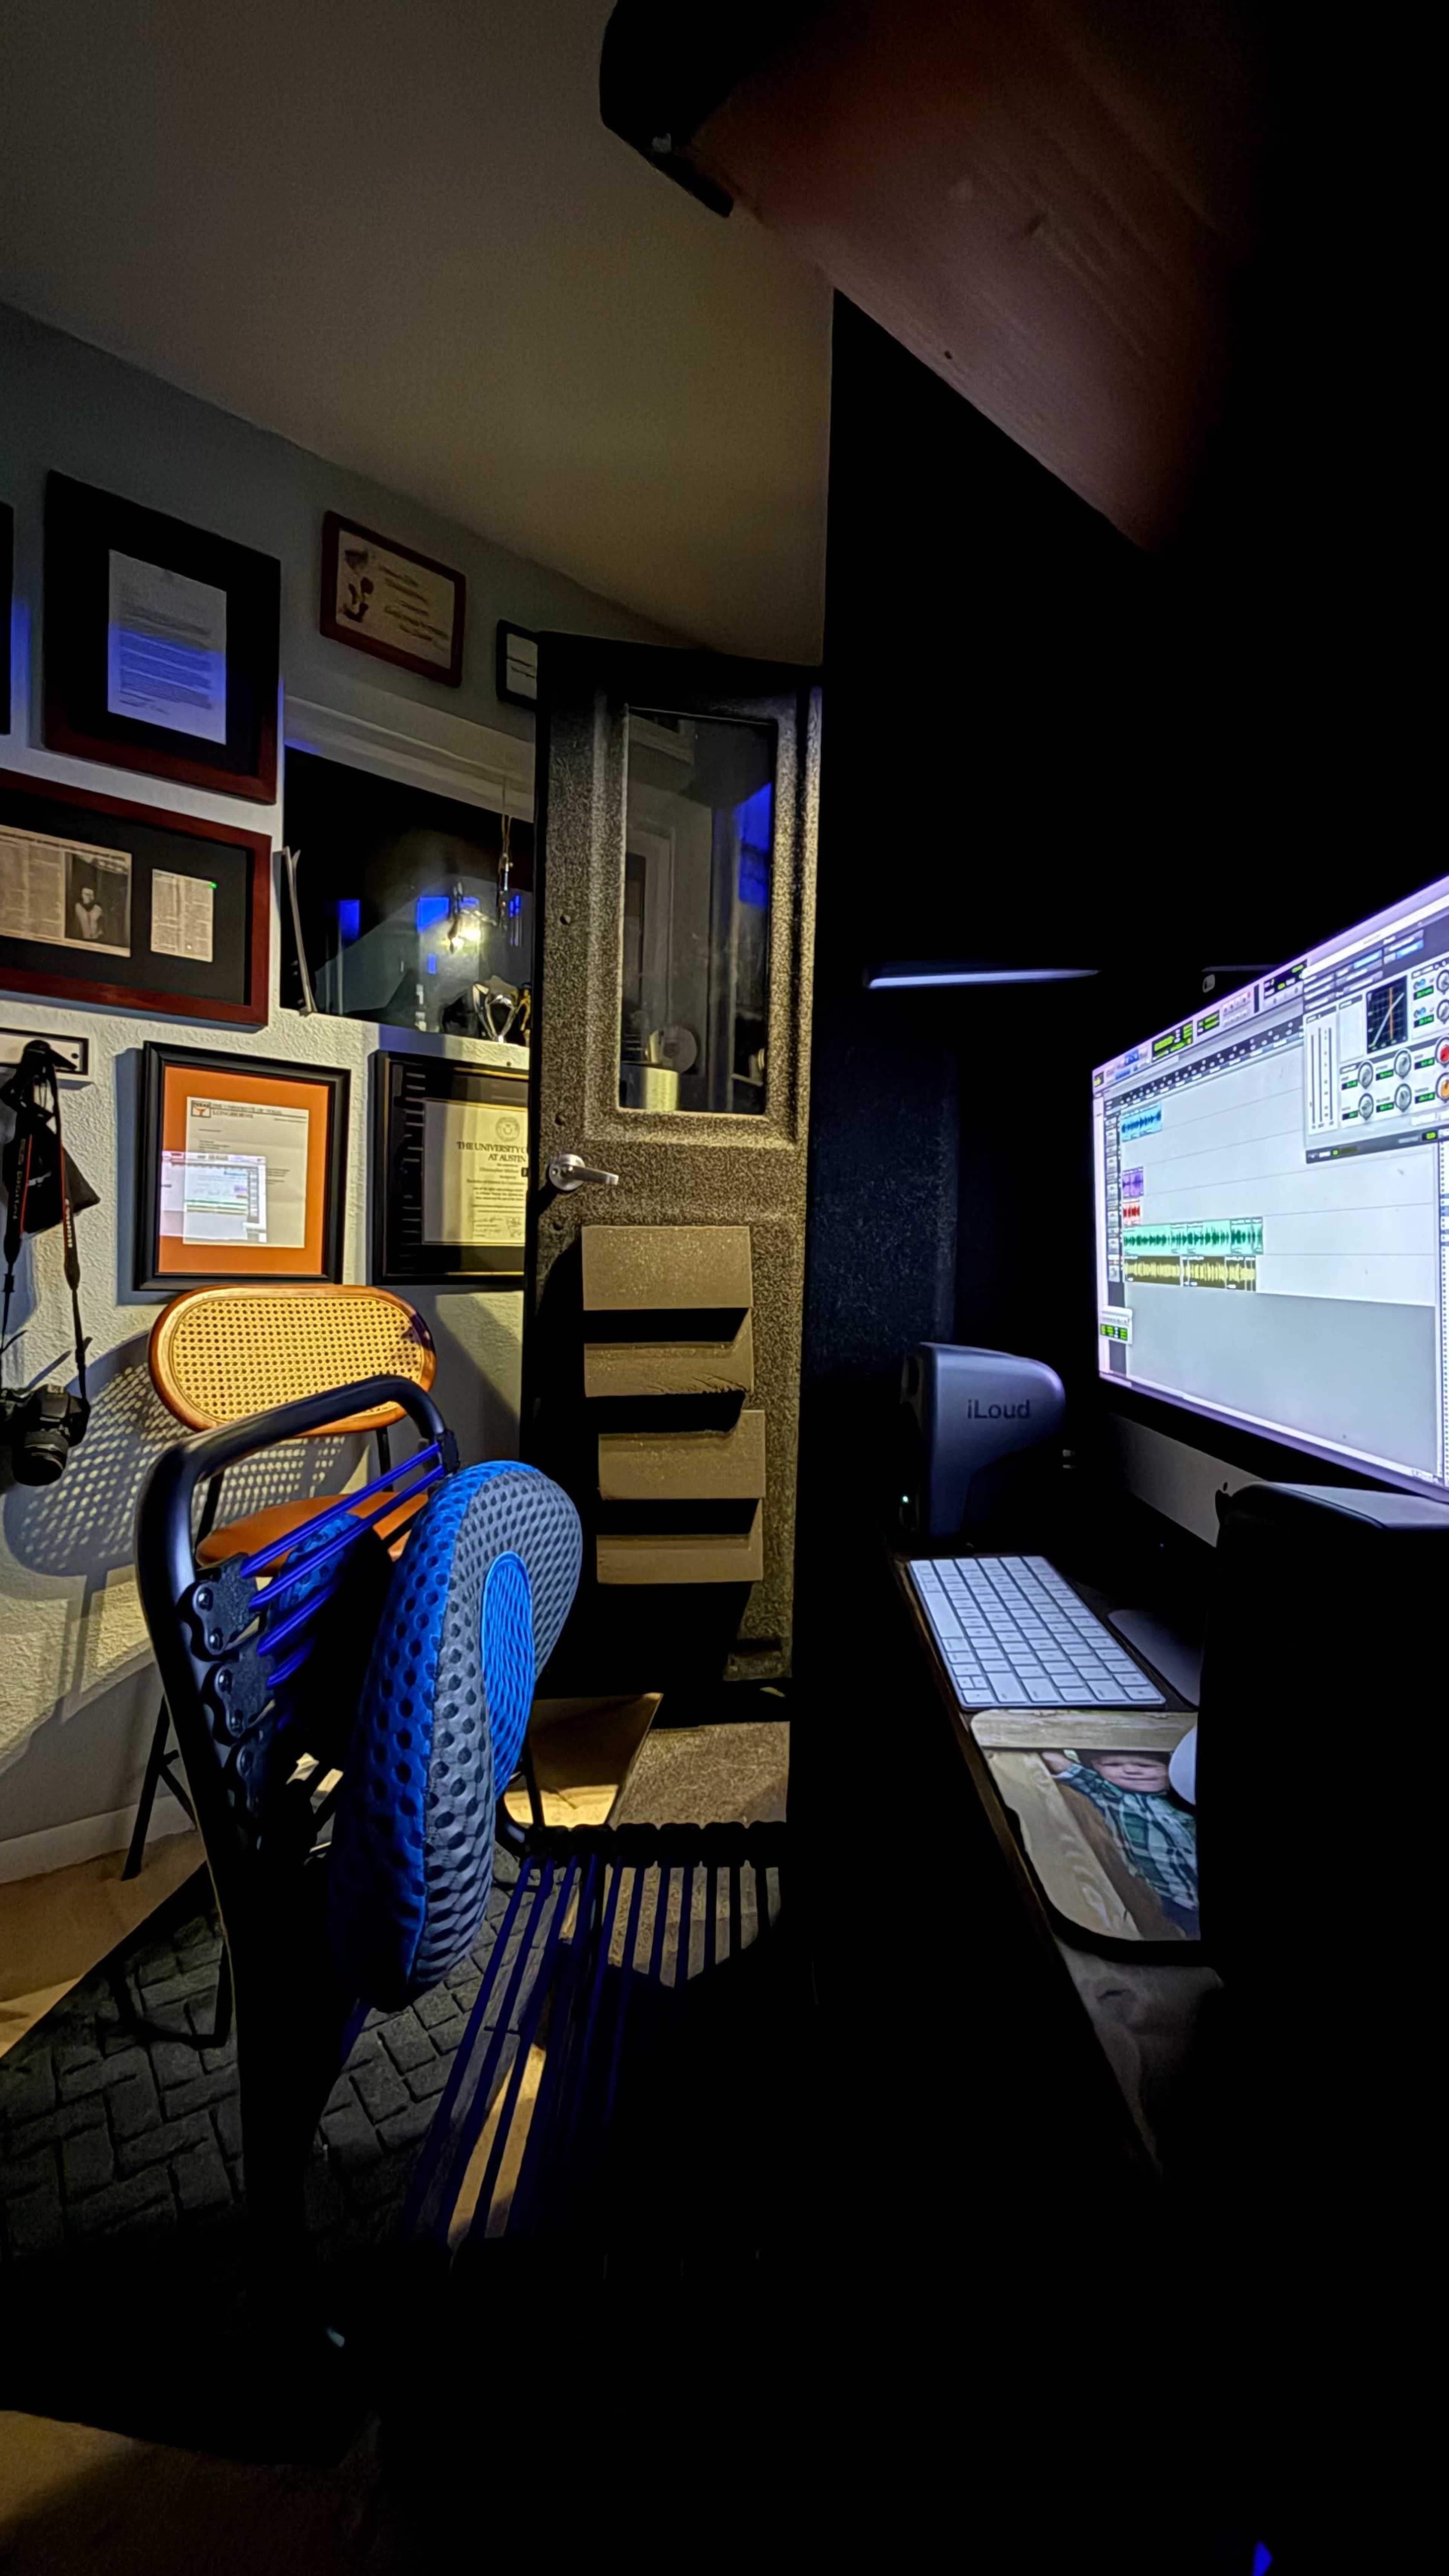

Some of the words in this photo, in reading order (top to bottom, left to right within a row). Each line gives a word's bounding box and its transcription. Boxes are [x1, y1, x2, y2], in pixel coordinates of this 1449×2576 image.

[457, 1141, 473, 1150] THE
[474, 1143, 520, 1153] UNIVERSITY
[499, 1154, 526, 1162] AUSTIN
[968, 1399, 1031, 1419] iLoud
